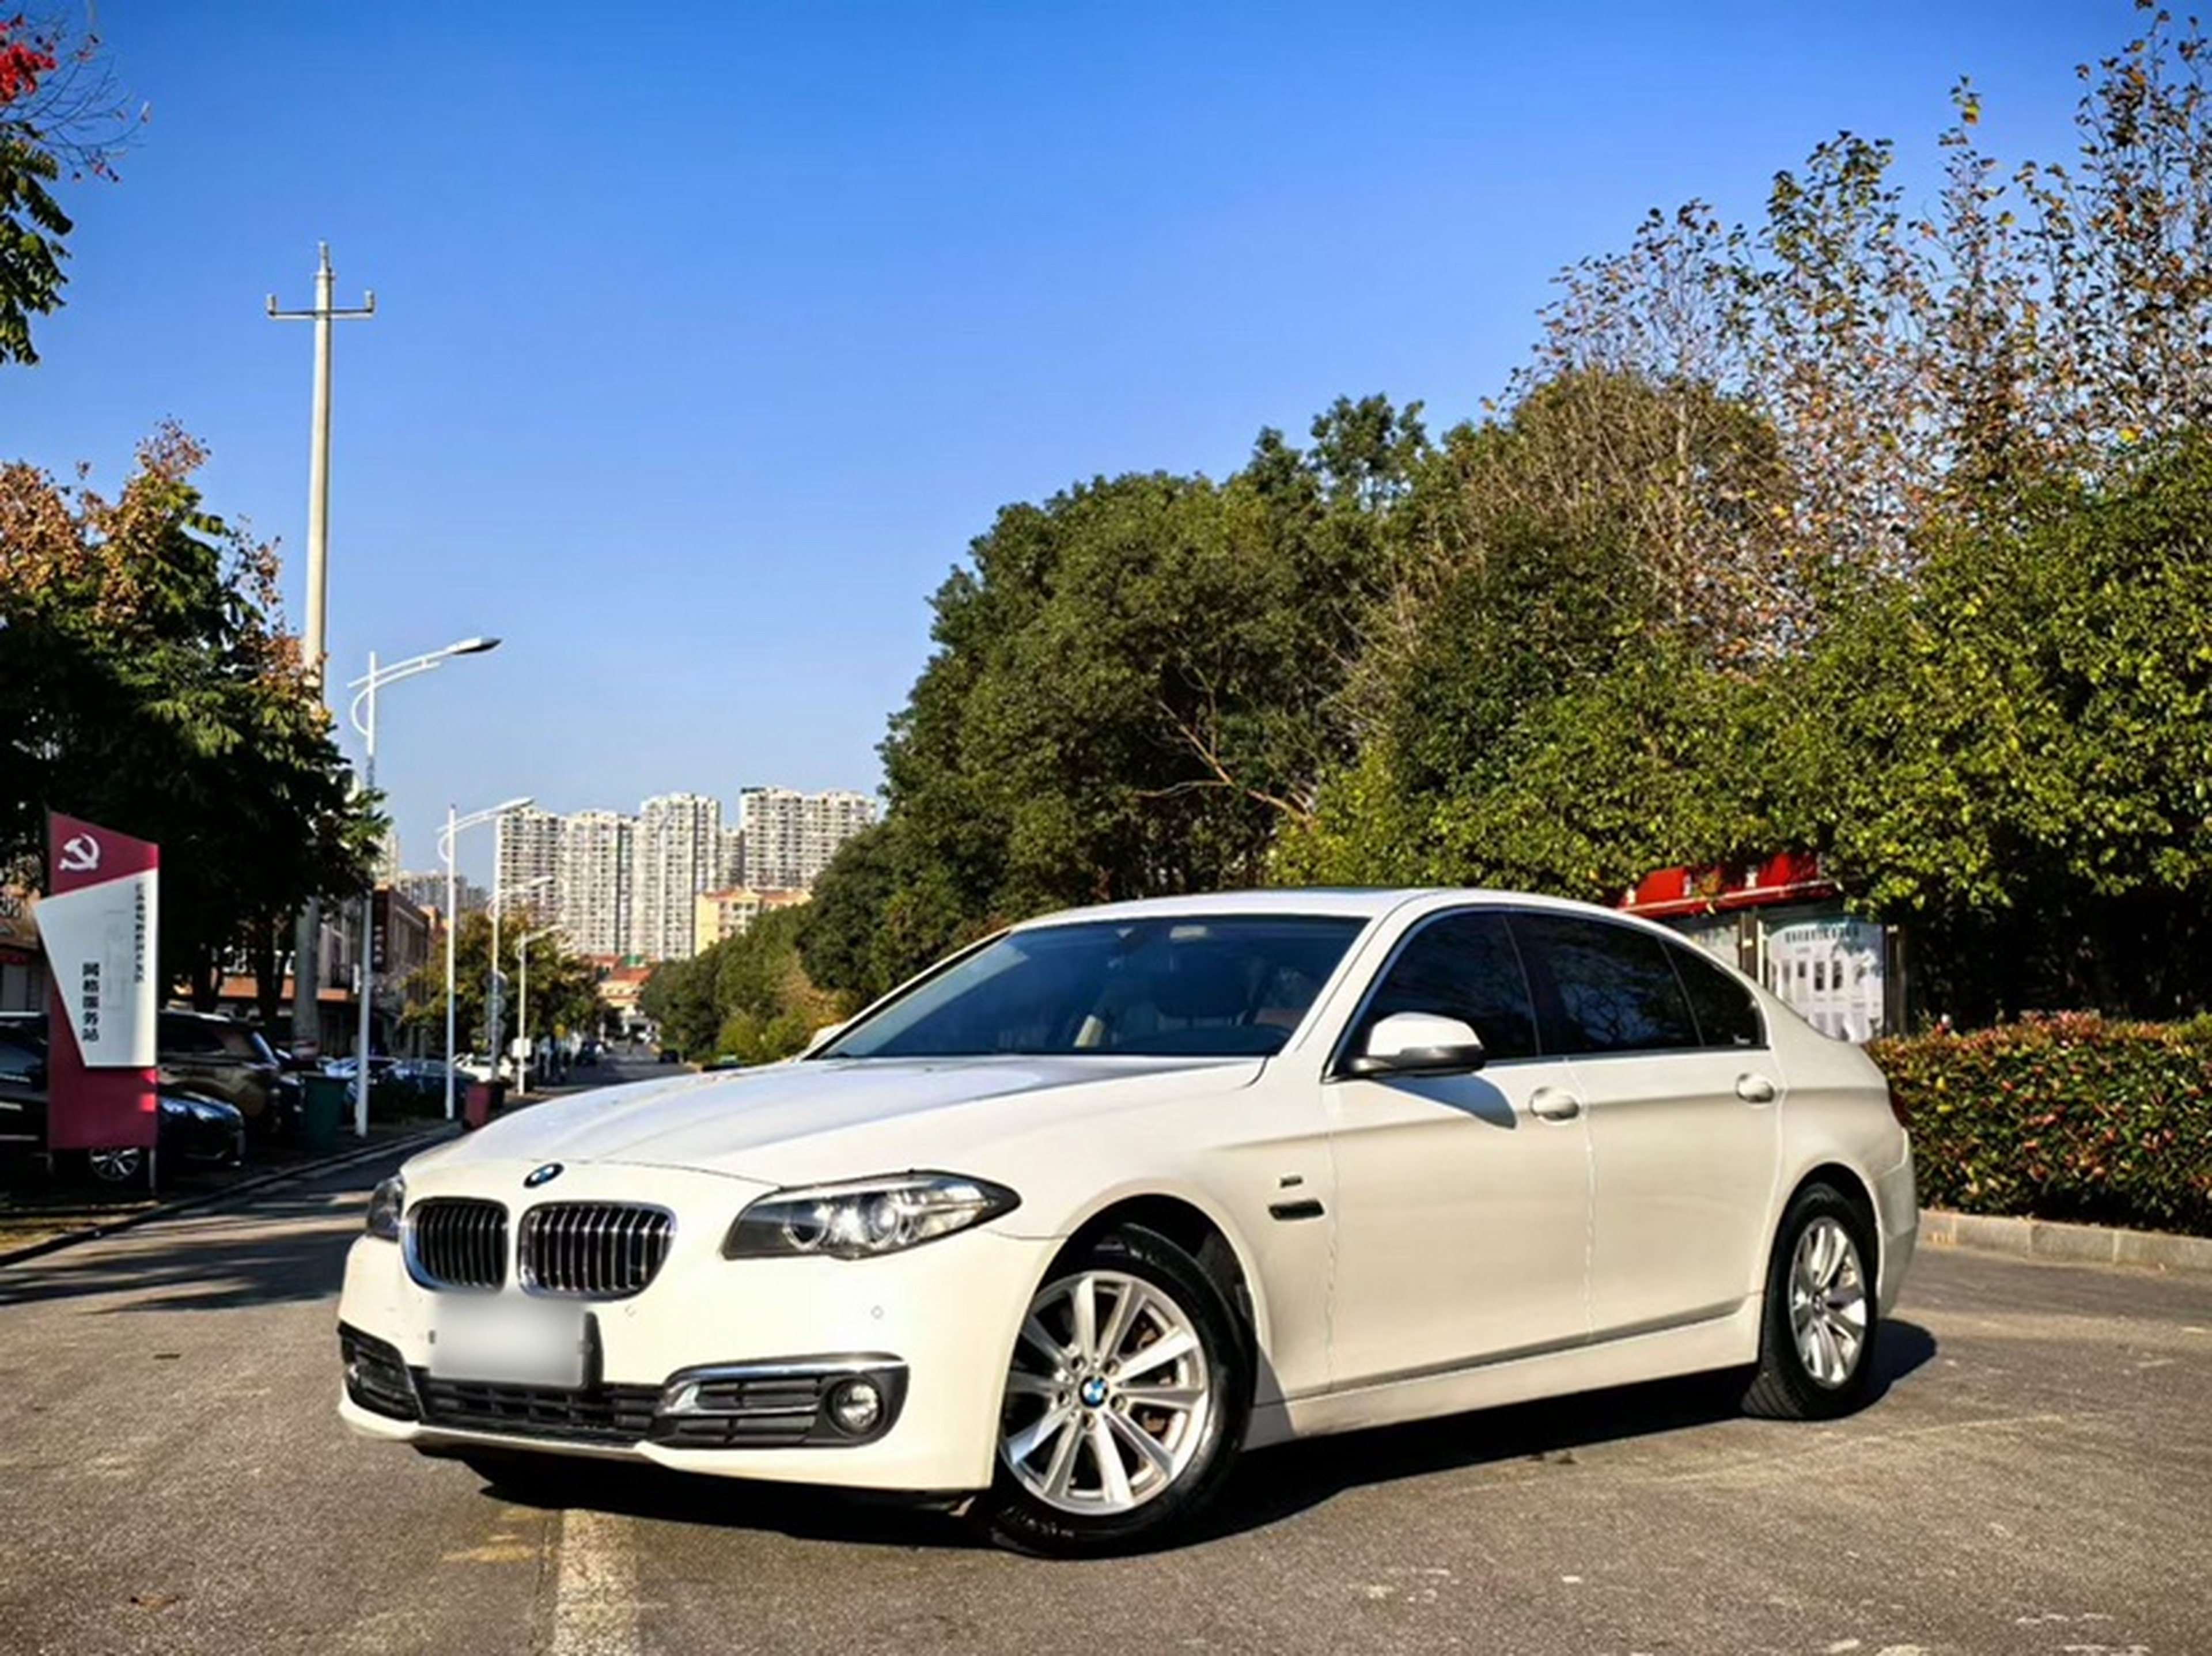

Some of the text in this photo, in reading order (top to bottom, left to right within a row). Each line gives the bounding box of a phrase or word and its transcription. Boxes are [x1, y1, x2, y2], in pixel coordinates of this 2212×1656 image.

[82, 962, 100, 1042] 网格服务站
